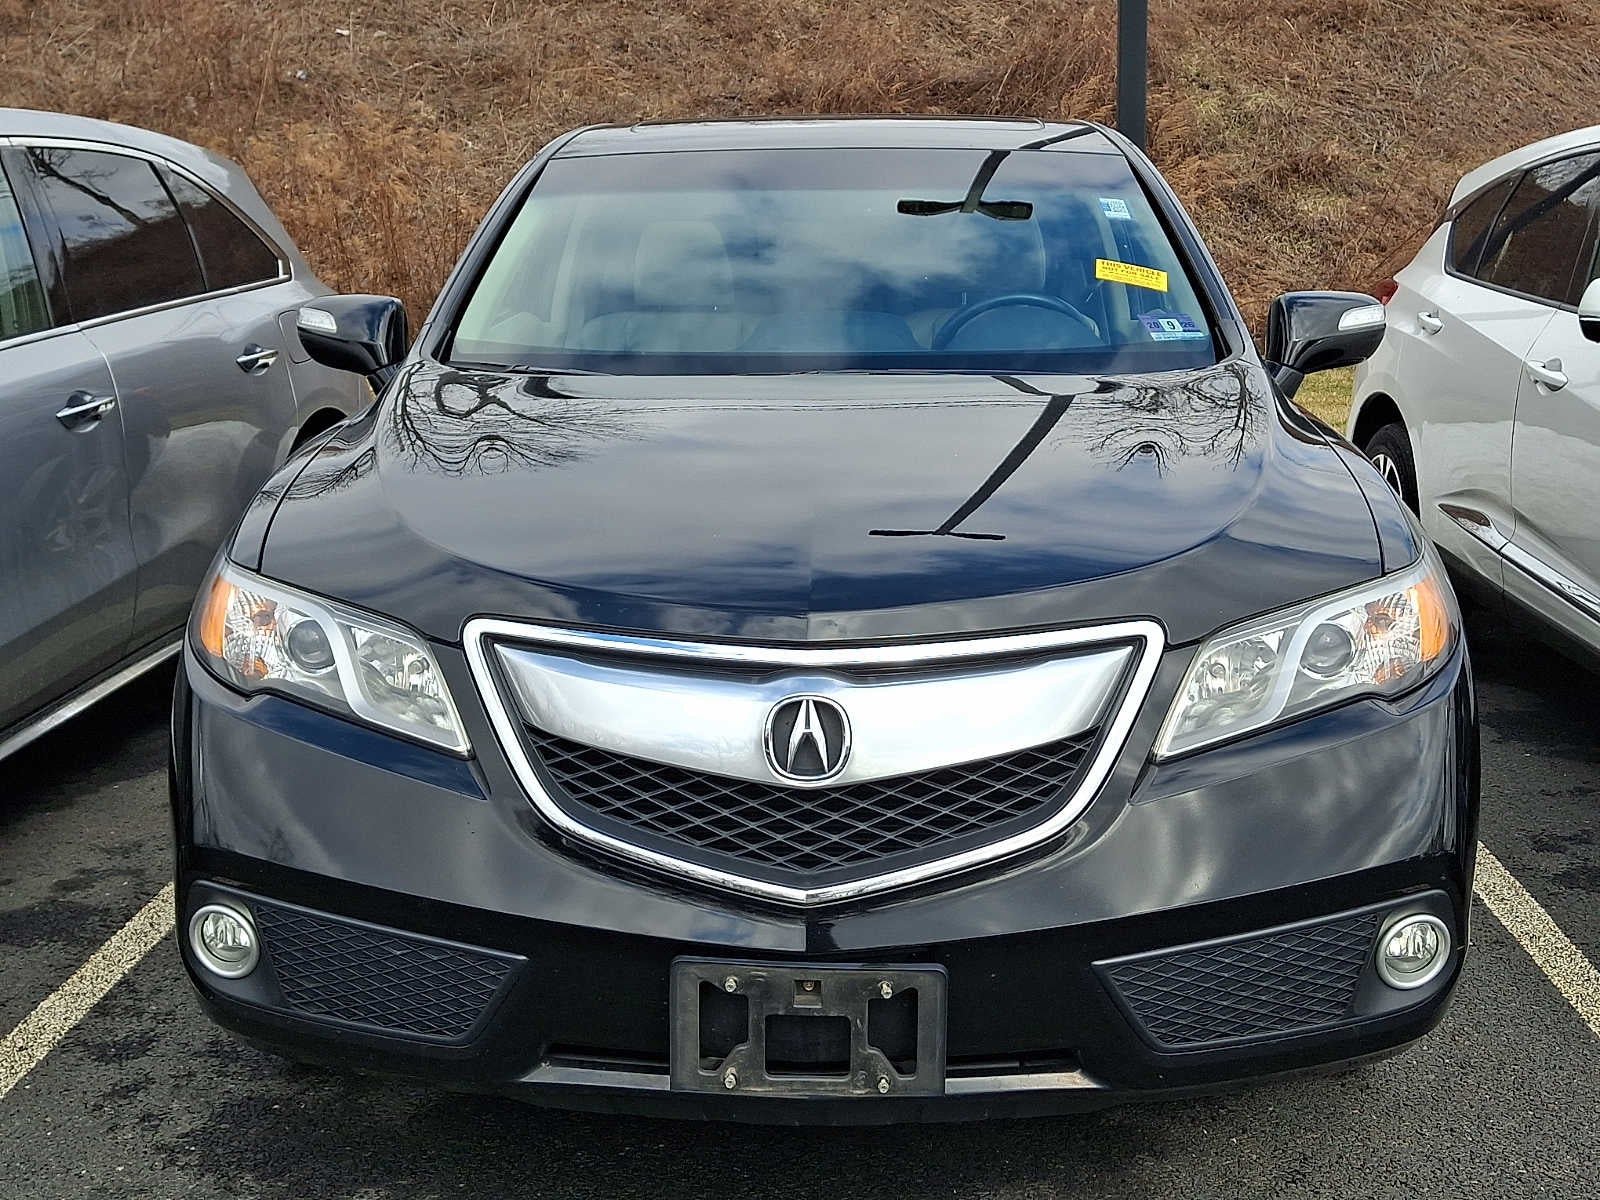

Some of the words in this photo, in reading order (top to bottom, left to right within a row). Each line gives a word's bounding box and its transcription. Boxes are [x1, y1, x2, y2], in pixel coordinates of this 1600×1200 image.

[1101, 261, 1121, 269] THIS
[1123, 264, 1162, 276] VEHICLE
[1146, 321, 1160, 329] 20
[1166, 320, 1176, 330] 9
